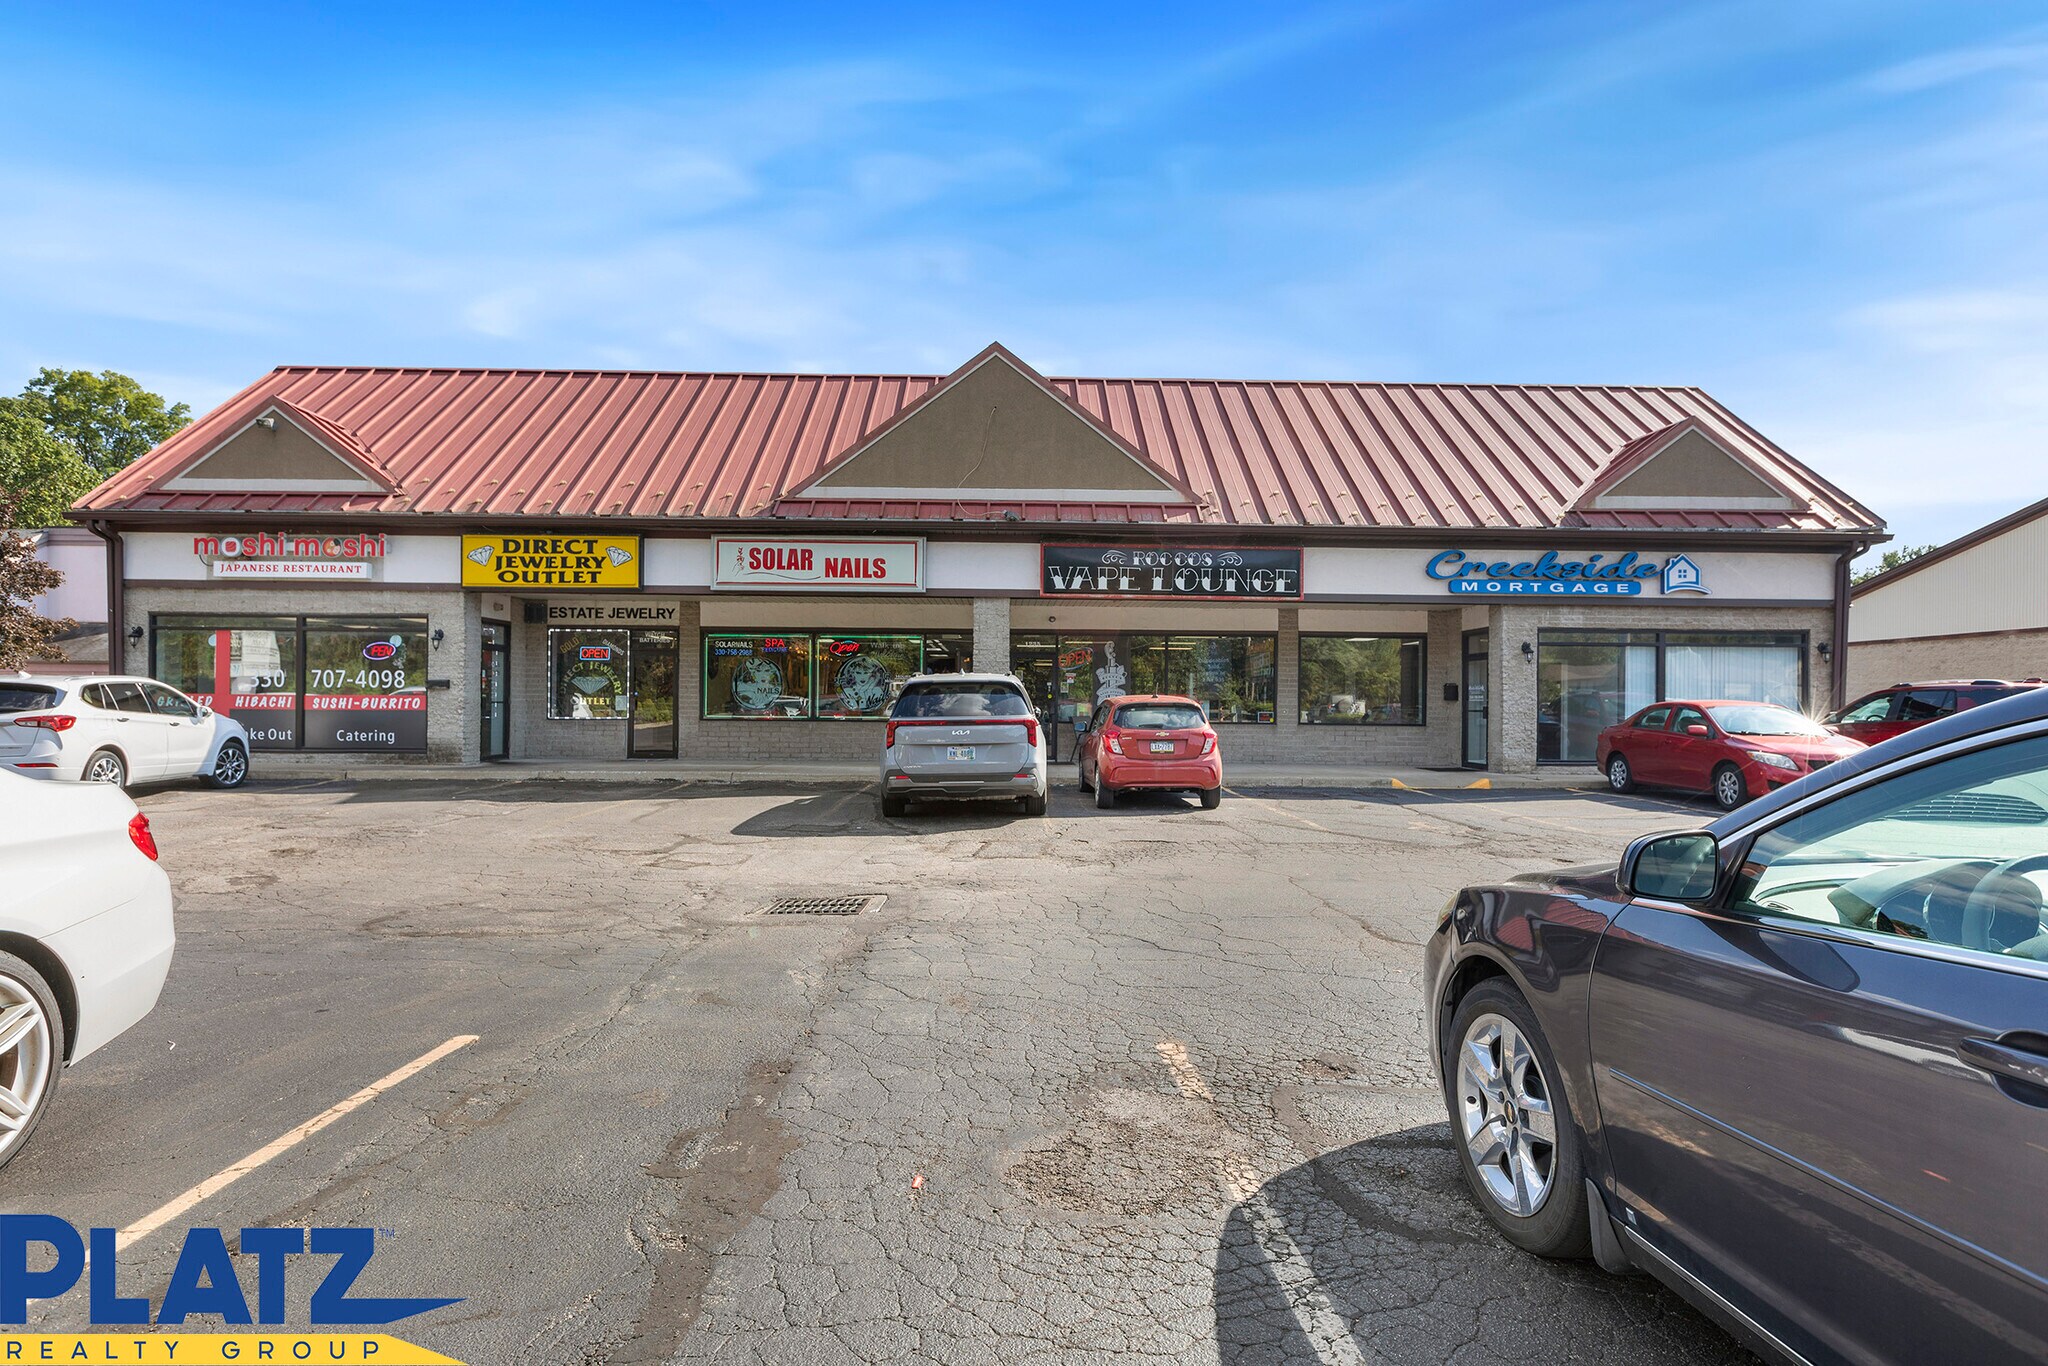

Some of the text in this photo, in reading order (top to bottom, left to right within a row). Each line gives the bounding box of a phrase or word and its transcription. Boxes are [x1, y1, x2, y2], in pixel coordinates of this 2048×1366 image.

[502, 538, 598, 555] DIRECT
[495, 555, 607, 571] JEWELRY
[748, 547, 886, 579] SOLAR NAILS
[1132, 551, 1213, 567] ROCCOS
[1425, 550, 1665, 580] Creekside
[219, 563, 363, 574] JAPANESE RESTAURANT
[497, 570, 603, 583] OUTLET
[1047, 566, 1298, 593] VAPE LOUNGE
[1461, 581, 1630, 594] MORTGAGE
[548, 607, 676, 620] ESTATE JEWELRY
[560, 637, 580, 654] GOLD
[764, 638, 785, 648] SPA
[829, 641, 860, 654] Open
[371, 645, 394, 657] PEN
[581, 649, 609, 659] OPEN
[1058, 649, 1093, 668] OPEN
[250, 669, 285, 688] 330
[311, 669, 405, 688] 707-4098
[157, 694, 213, 707] GRED
[235, 696, 293, 708] HIBACHI
[312, 697, 421, 709] SUSHI-BURRITO
[246, 727, 293, 740] ke Out
[336, 729, 396, 744] Catering
